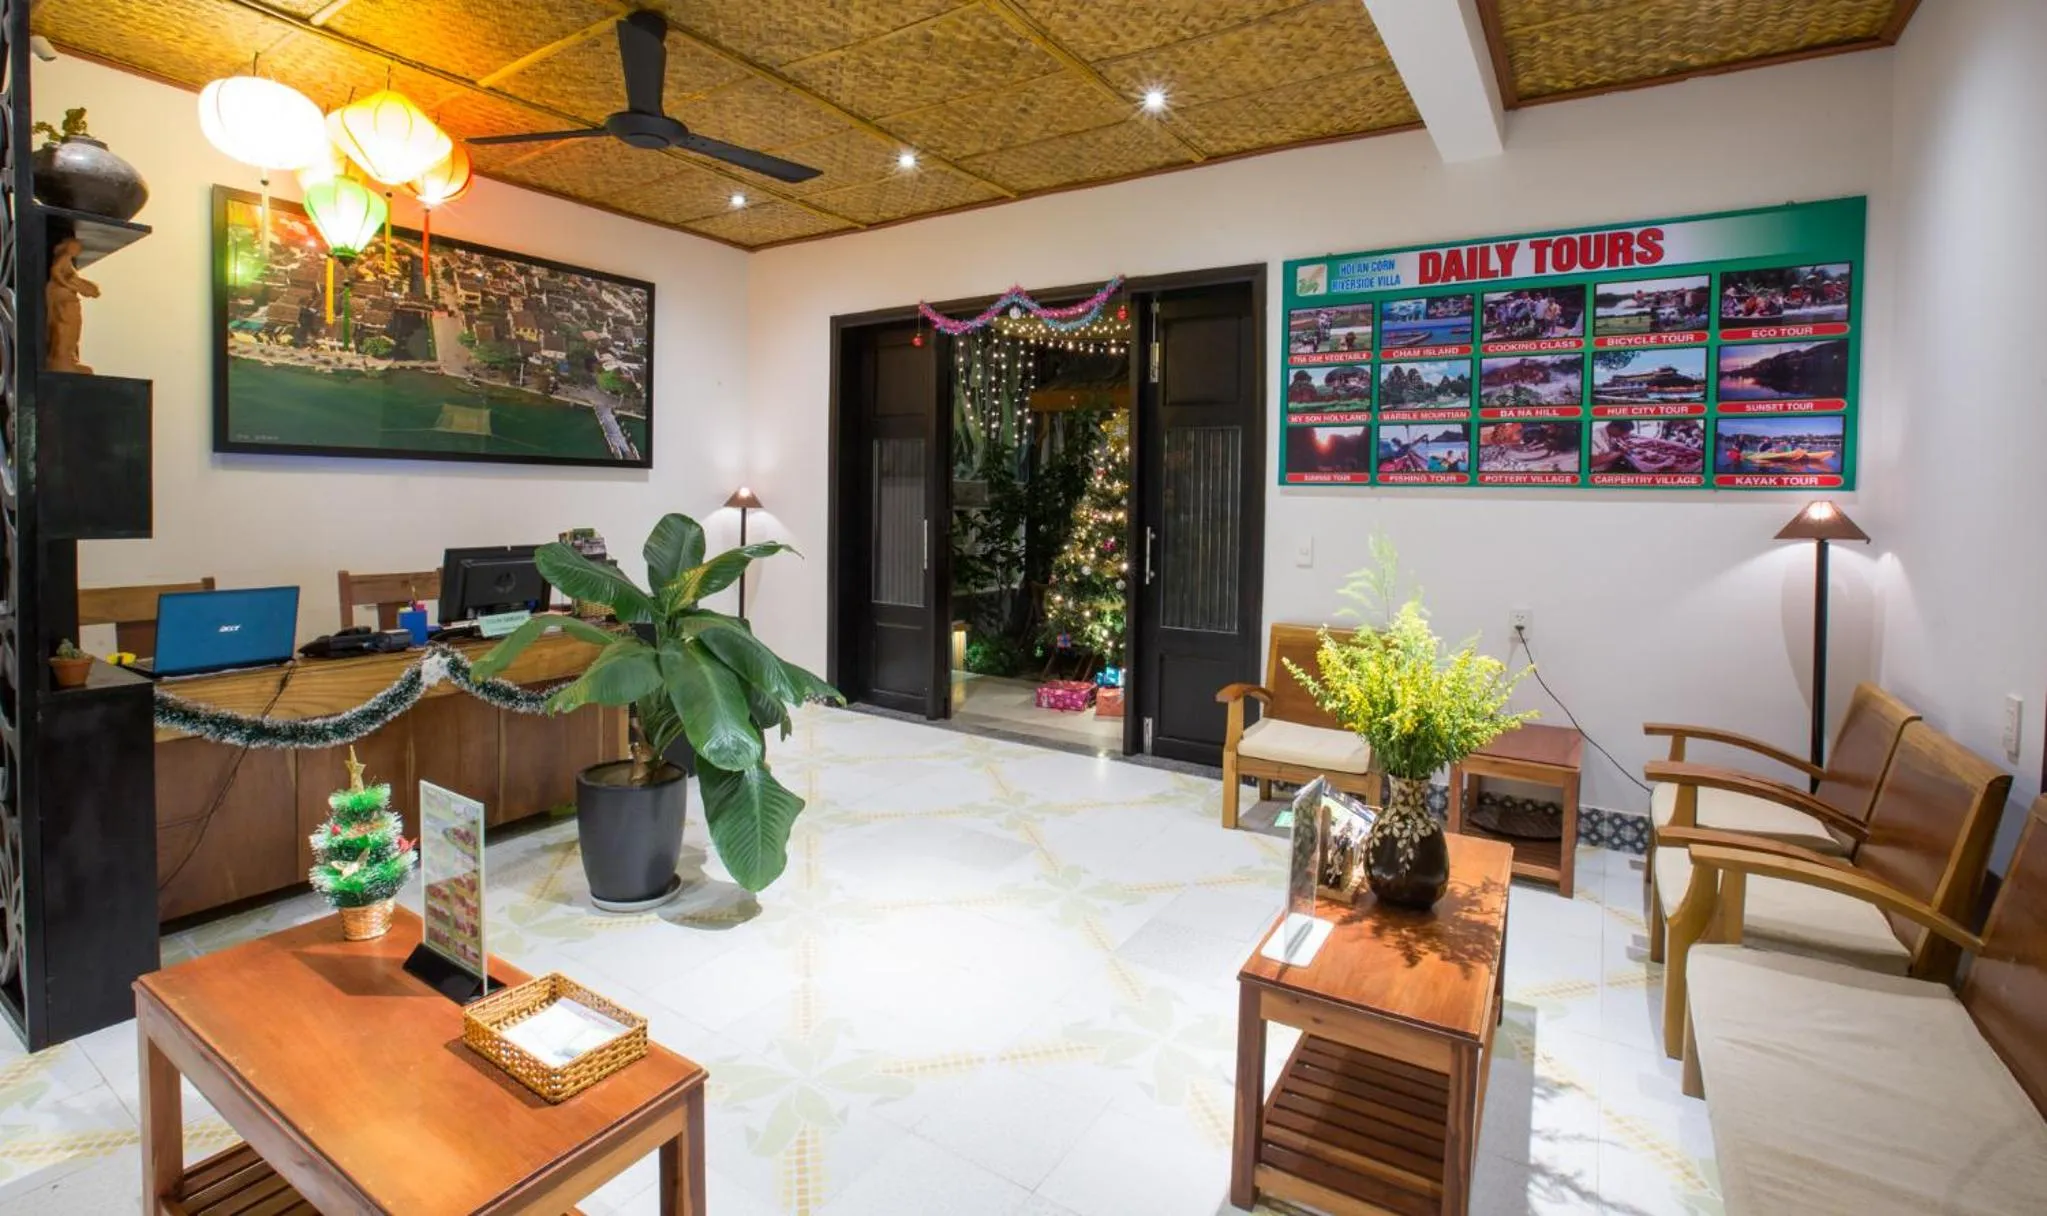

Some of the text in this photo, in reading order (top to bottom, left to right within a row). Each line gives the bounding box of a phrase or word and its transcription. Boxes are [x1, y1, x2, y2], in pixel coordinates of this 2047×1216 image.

[1419, 227, 1665, 285] DAILY TOURS
[1357, 262, 1369, 273] AN
[1371, 259, 1396, 272] CORN
[1332, 274, 1402, 290] RIVERSIDE VILLA
[1751, 327, 1814, 339] ECO TOUR
[1606, 333, 1695, 346] BICYCLE TOUR
[1488, 340, 1576, 352] COOKING CLASS
[1325, 353, 1367, 362] VEGETABLE
[1392, 347, 1459, 358] CHAM ISLAND
[1607, 405, 1689, 416] HUE CITY TOUR
[1745, 402, 1814, 412] SUNSET TOUR
[1304, 415, 1322, 423] SON
[1323, 413, 1367, 422] HOLYLAND
[1383, 412, 1418, 421] MARBLE
[1500, 408, 1559, 418] BA NA HILL
[1388, 474, 1457, 482] FISHING TOUR
[1485, 475, 1571, 483] POTTERY VILLAGE
[1594, 475, 1698, 484] CARPENTRY VILLAGE
[1735, 477, 1819, 486] KAYAK TOUR
